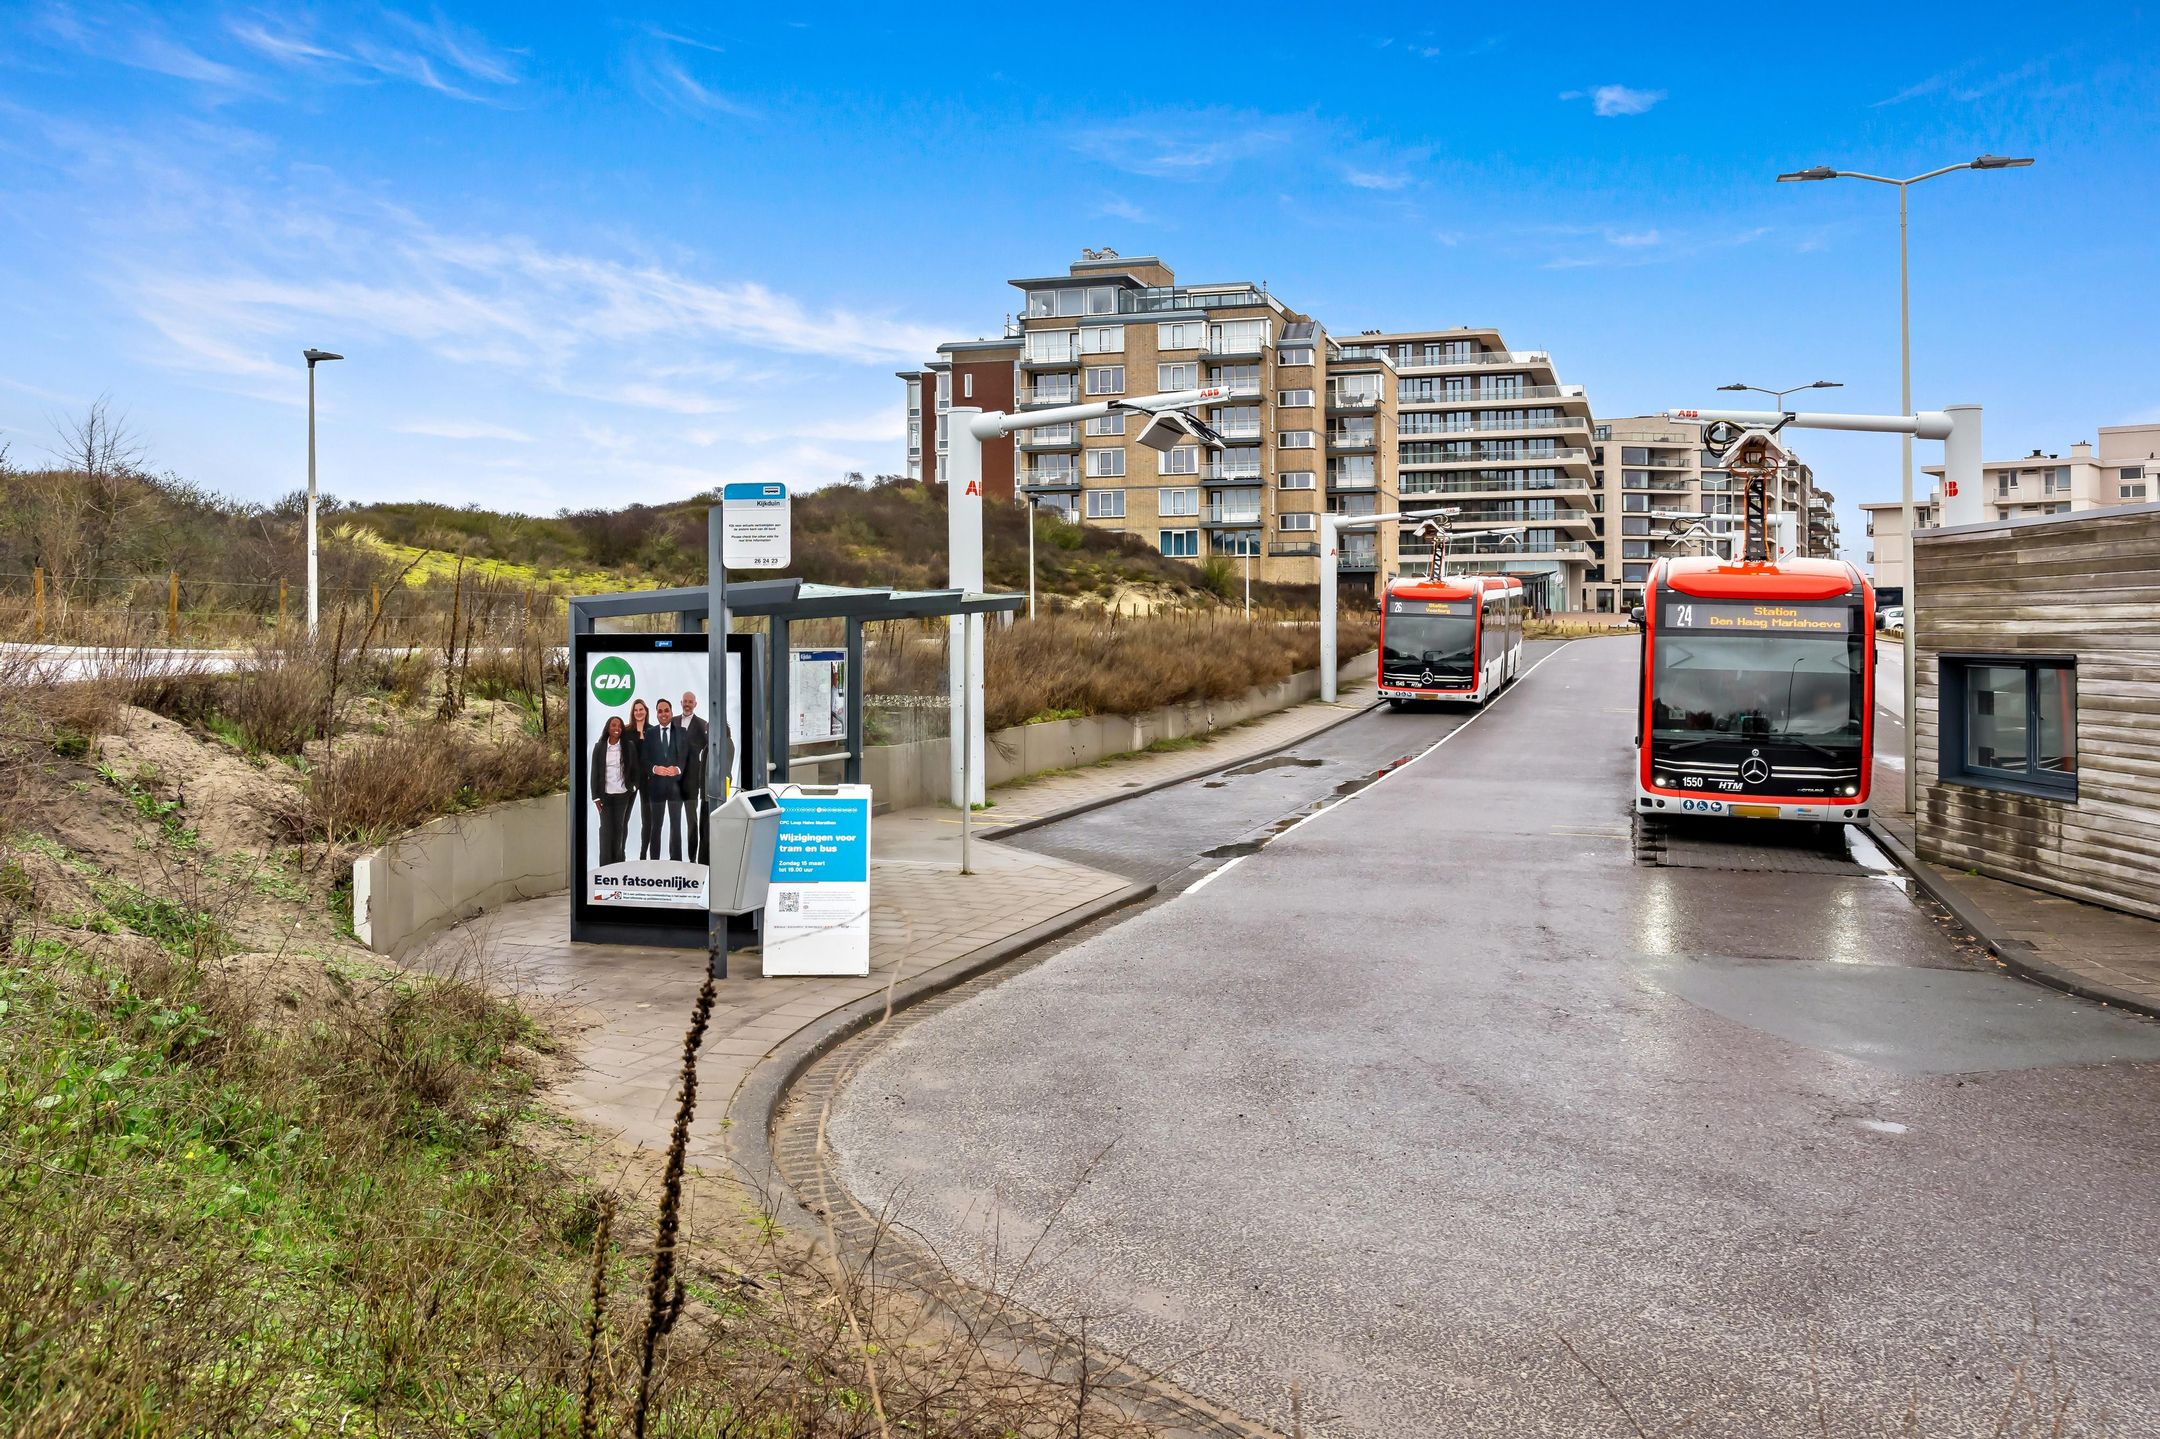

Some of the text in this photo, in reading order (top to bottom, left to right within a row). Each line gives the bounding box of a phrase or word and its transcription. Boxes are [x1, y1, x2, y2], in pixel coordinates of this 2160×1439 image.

[1200, 389, 1220, 398] ABB
[1394, 602, 1402, 612] 26
[1754, 607, 1797, 616] Station
[1677, 605, 1692, 626] 24
[1710, 617, 1841, 628] Den Haag Mariahoeve
[595, 674, 630, 688] CDA
[1683, 776, 1703, 787] 1550
[1718, 781, 1744, 790] HTM
[780, 833, 833, 843] Wijzigingen
[594, 875, 618, 885] Een
[622, 875, 699, 890] fatsoenlijke
